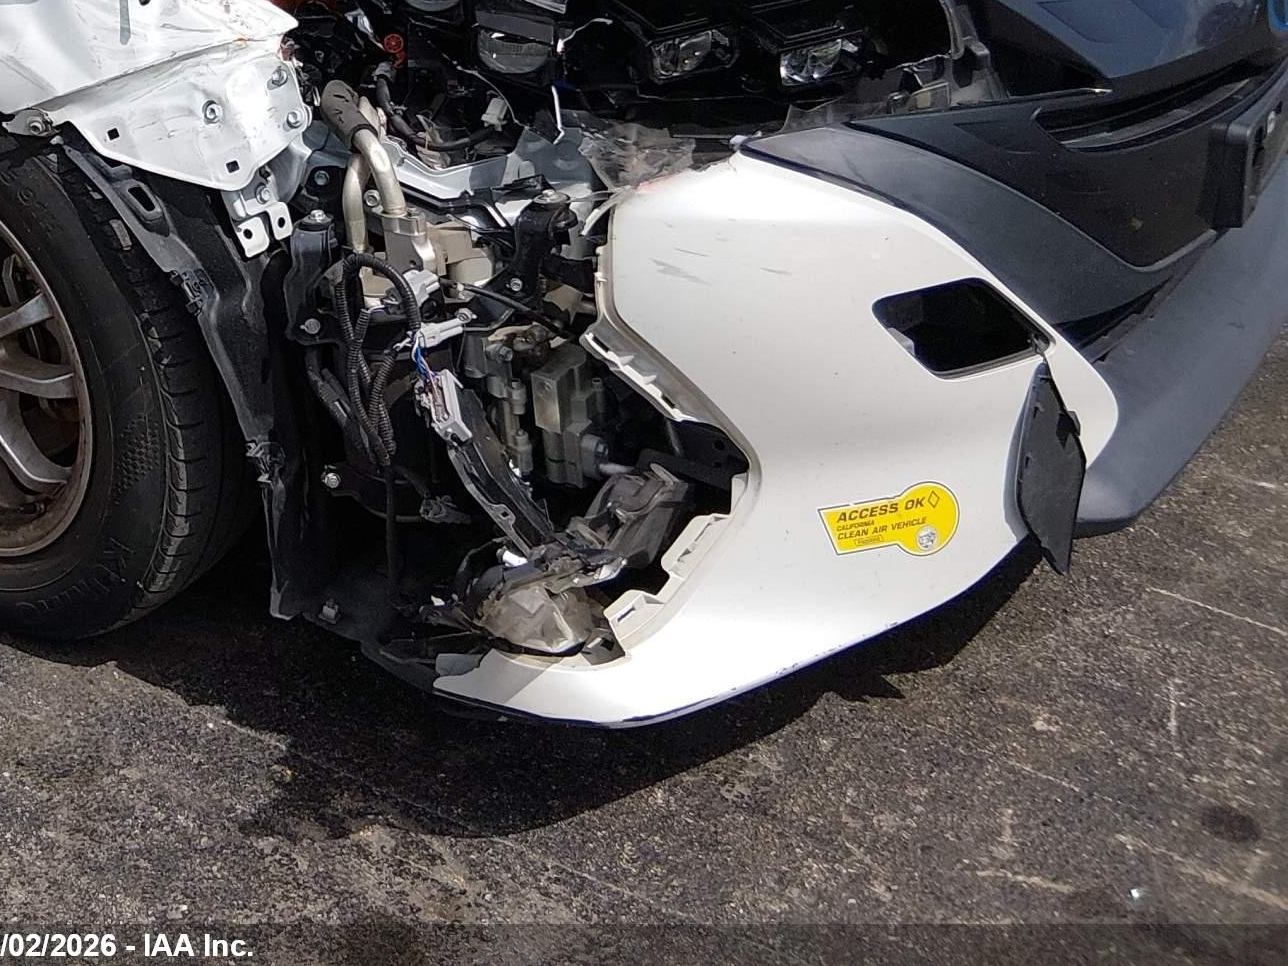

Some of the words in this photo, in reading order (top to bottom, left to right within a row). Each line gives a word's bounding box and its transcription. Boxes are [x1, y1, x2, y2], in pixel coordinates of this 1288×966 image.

[836, 502, 899, 524] ACCESS
[904, 497, 926, 511] OK
[836, 520, 875, 532] CALIFORNIA
[837, 528, 869, 540] CLEAN
[871, 525, 888, 535] AIR
[890, 516, 928, 531] VEHICLE
